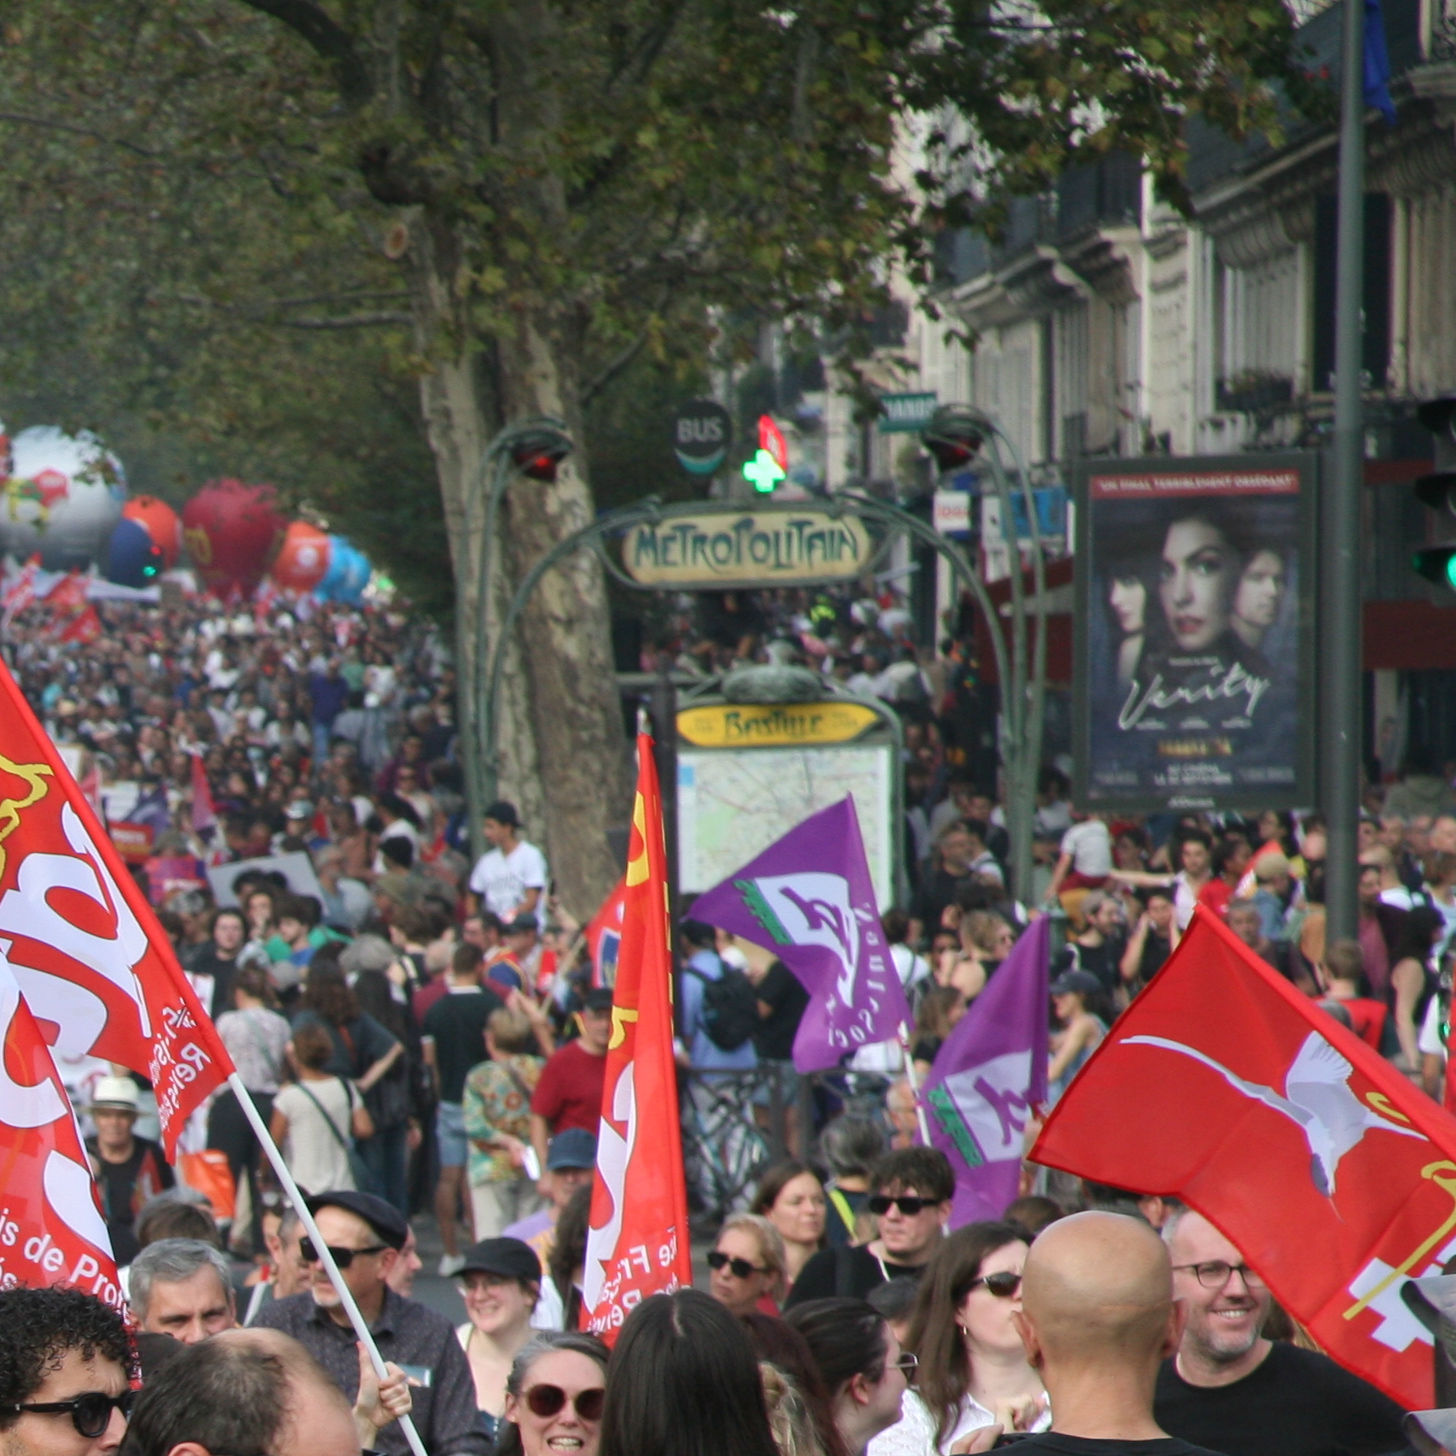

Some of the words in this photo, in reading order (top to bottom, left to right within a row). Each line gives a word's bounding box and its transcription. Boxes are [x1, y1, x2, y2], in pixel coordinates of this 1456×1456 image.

[677, 416, 724, 444] BUS
[634, 517, 859, 575] METROPOLITAIN
[1117, 661, 1272, 731] Verity
[23, 1232, 65, 1273] de
